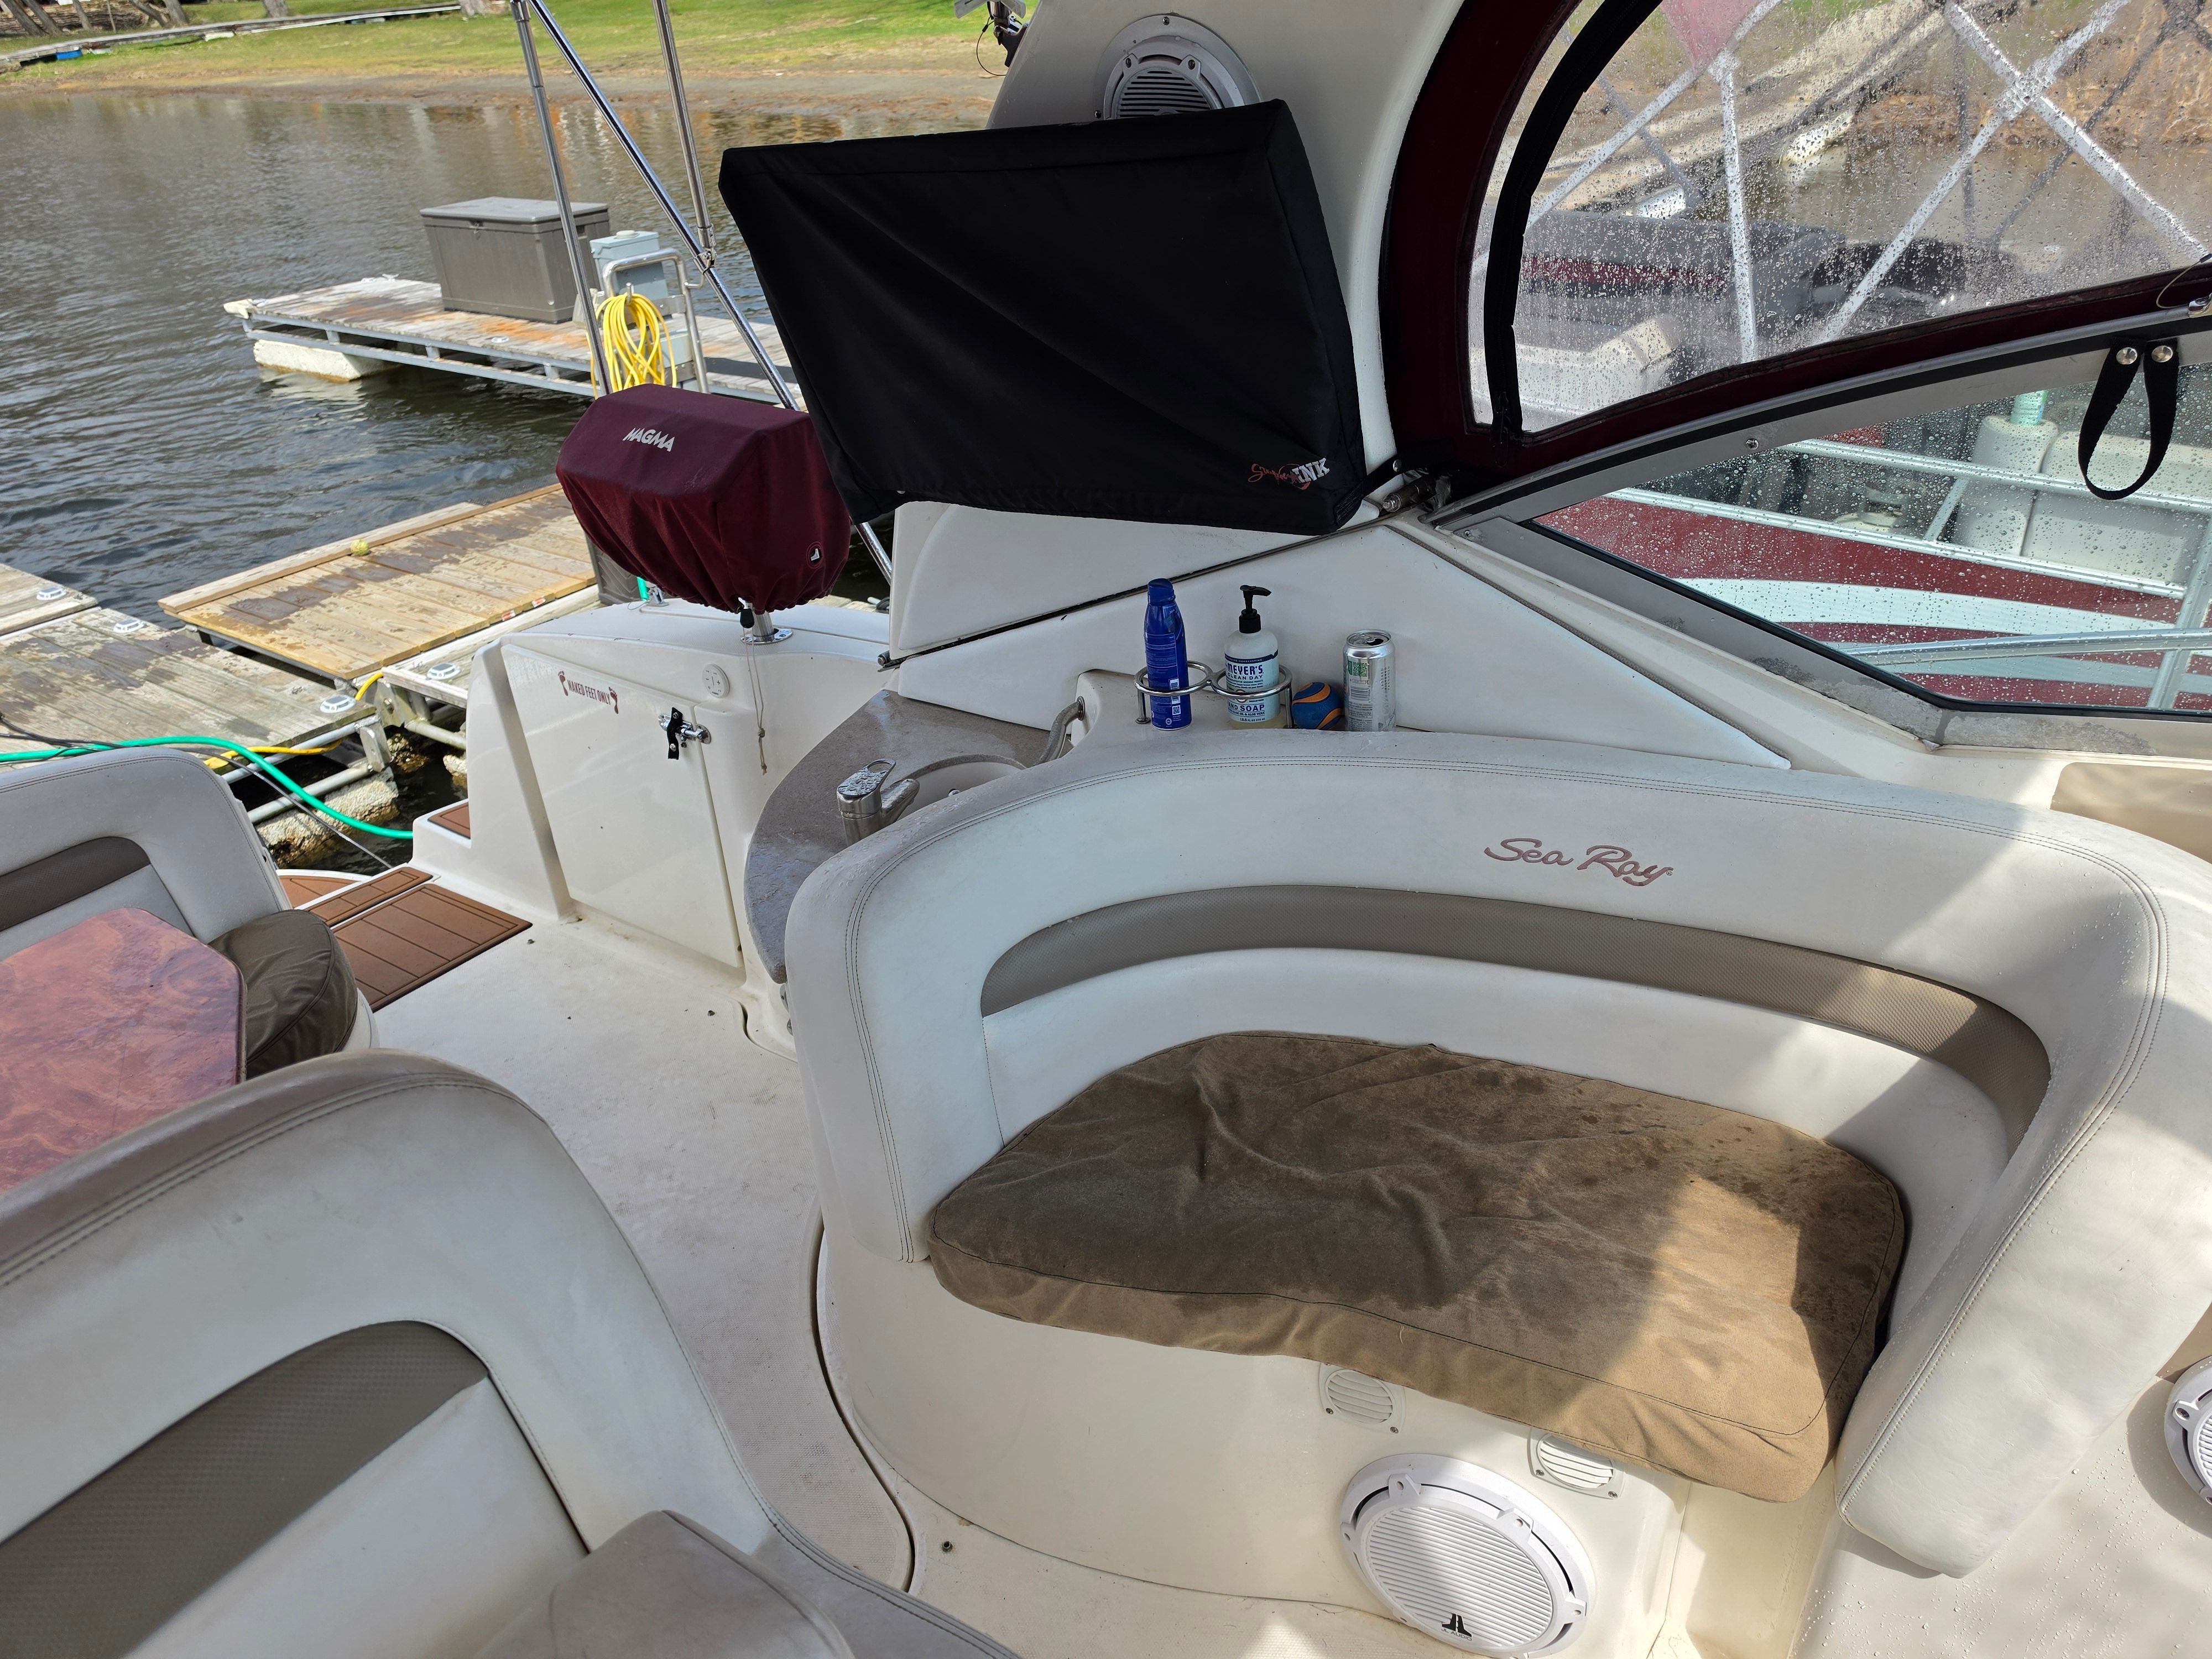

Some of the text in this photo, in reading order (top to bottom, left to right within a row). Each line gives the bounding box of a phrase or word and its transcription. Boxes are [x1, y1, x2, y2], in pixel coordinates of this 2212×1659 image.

[622, 427, 675, 452] MAGMA
[567, 680, 611, 705] NAKED FEET ONLY
[1484, 838, 1673, 886] Sea Ray
[1451, 1631, 1472, 1641] AUDIO
